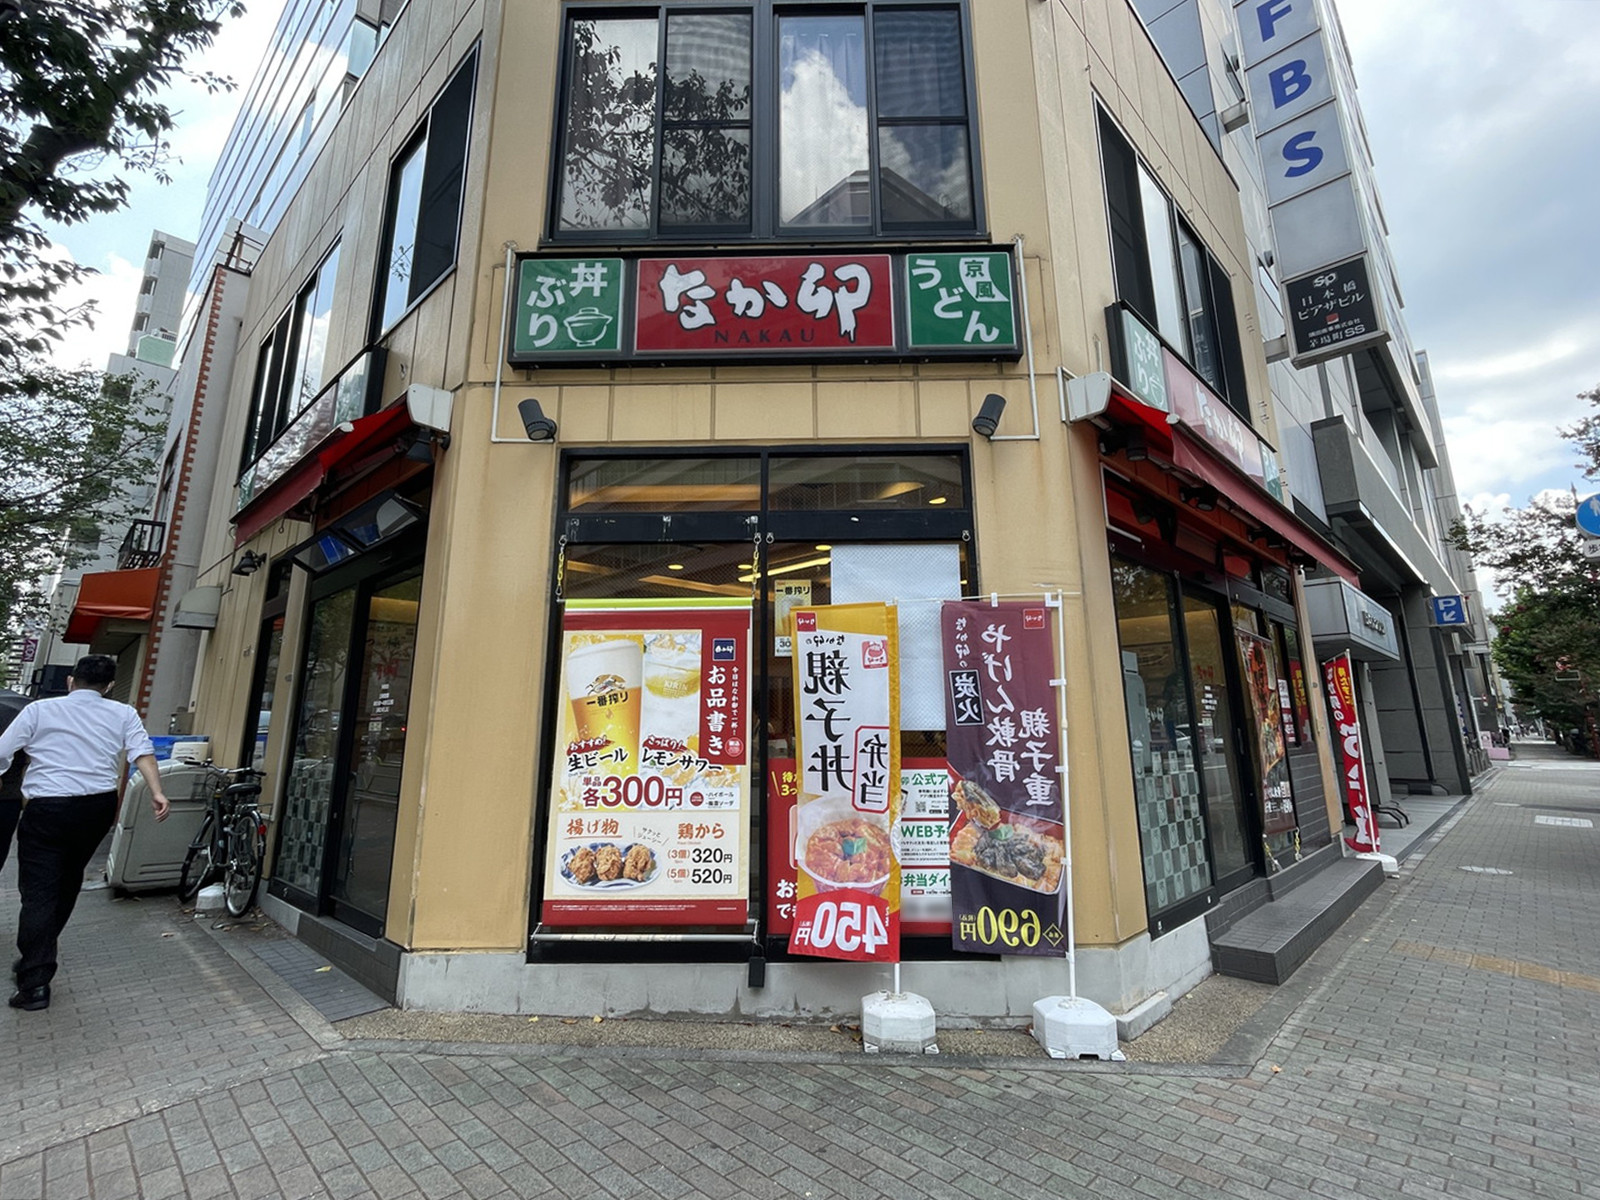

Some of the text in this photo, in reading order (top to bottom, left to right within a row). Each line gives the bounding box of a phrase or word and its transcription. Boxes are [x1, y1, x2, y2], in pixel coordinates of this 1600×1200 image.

[659, 261, 873, 343] なか卯
[911, 257, 1000, 343] うどん
[1298, 292, 1366, 321] ピアザビル
[713, 328, 816, 345] NAKAU
[1438, 598, 1457, 611] P
[586, 691, 629, 708] 一番搾り
[705, 665, 728, 756] お品書き
[567, 748, 629, 773] 生ビール
[641, 749, 723, 773] レモンサワー
[566, 818, 620, 836] 揚げ物
[677, 822, 726, 840] 鶏から
[900, 825, 950, 838] WEB予
[691, 847, 733, 864] 320円
[691, 868, 733, 884] 520円
[900, 873, 951, 887] 弁当ダイ
[775, 879, 798, 899] お
